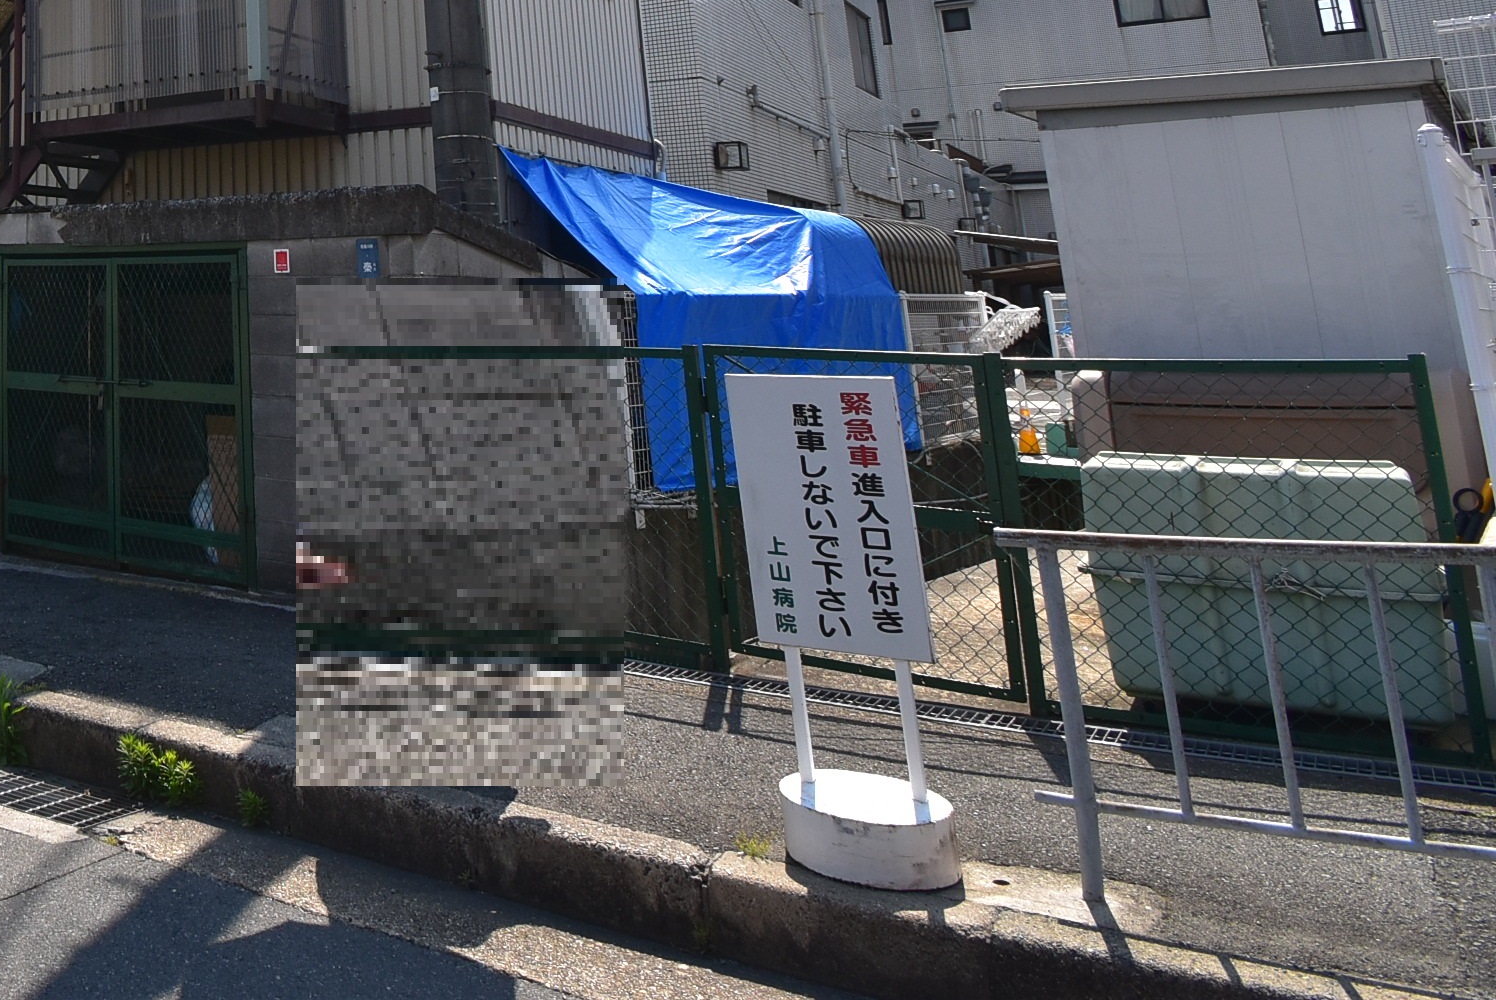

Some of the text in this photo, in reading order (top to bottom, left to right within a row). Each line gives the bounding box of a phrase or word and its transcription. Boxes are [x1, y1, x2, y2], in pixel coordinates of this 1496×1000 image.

[766, 536, 798, 635] 上山病院
[791, 403, 852, 638] 駐車しないで下さい
[839, 391, 904, 635] 緊急車進入口に付き
